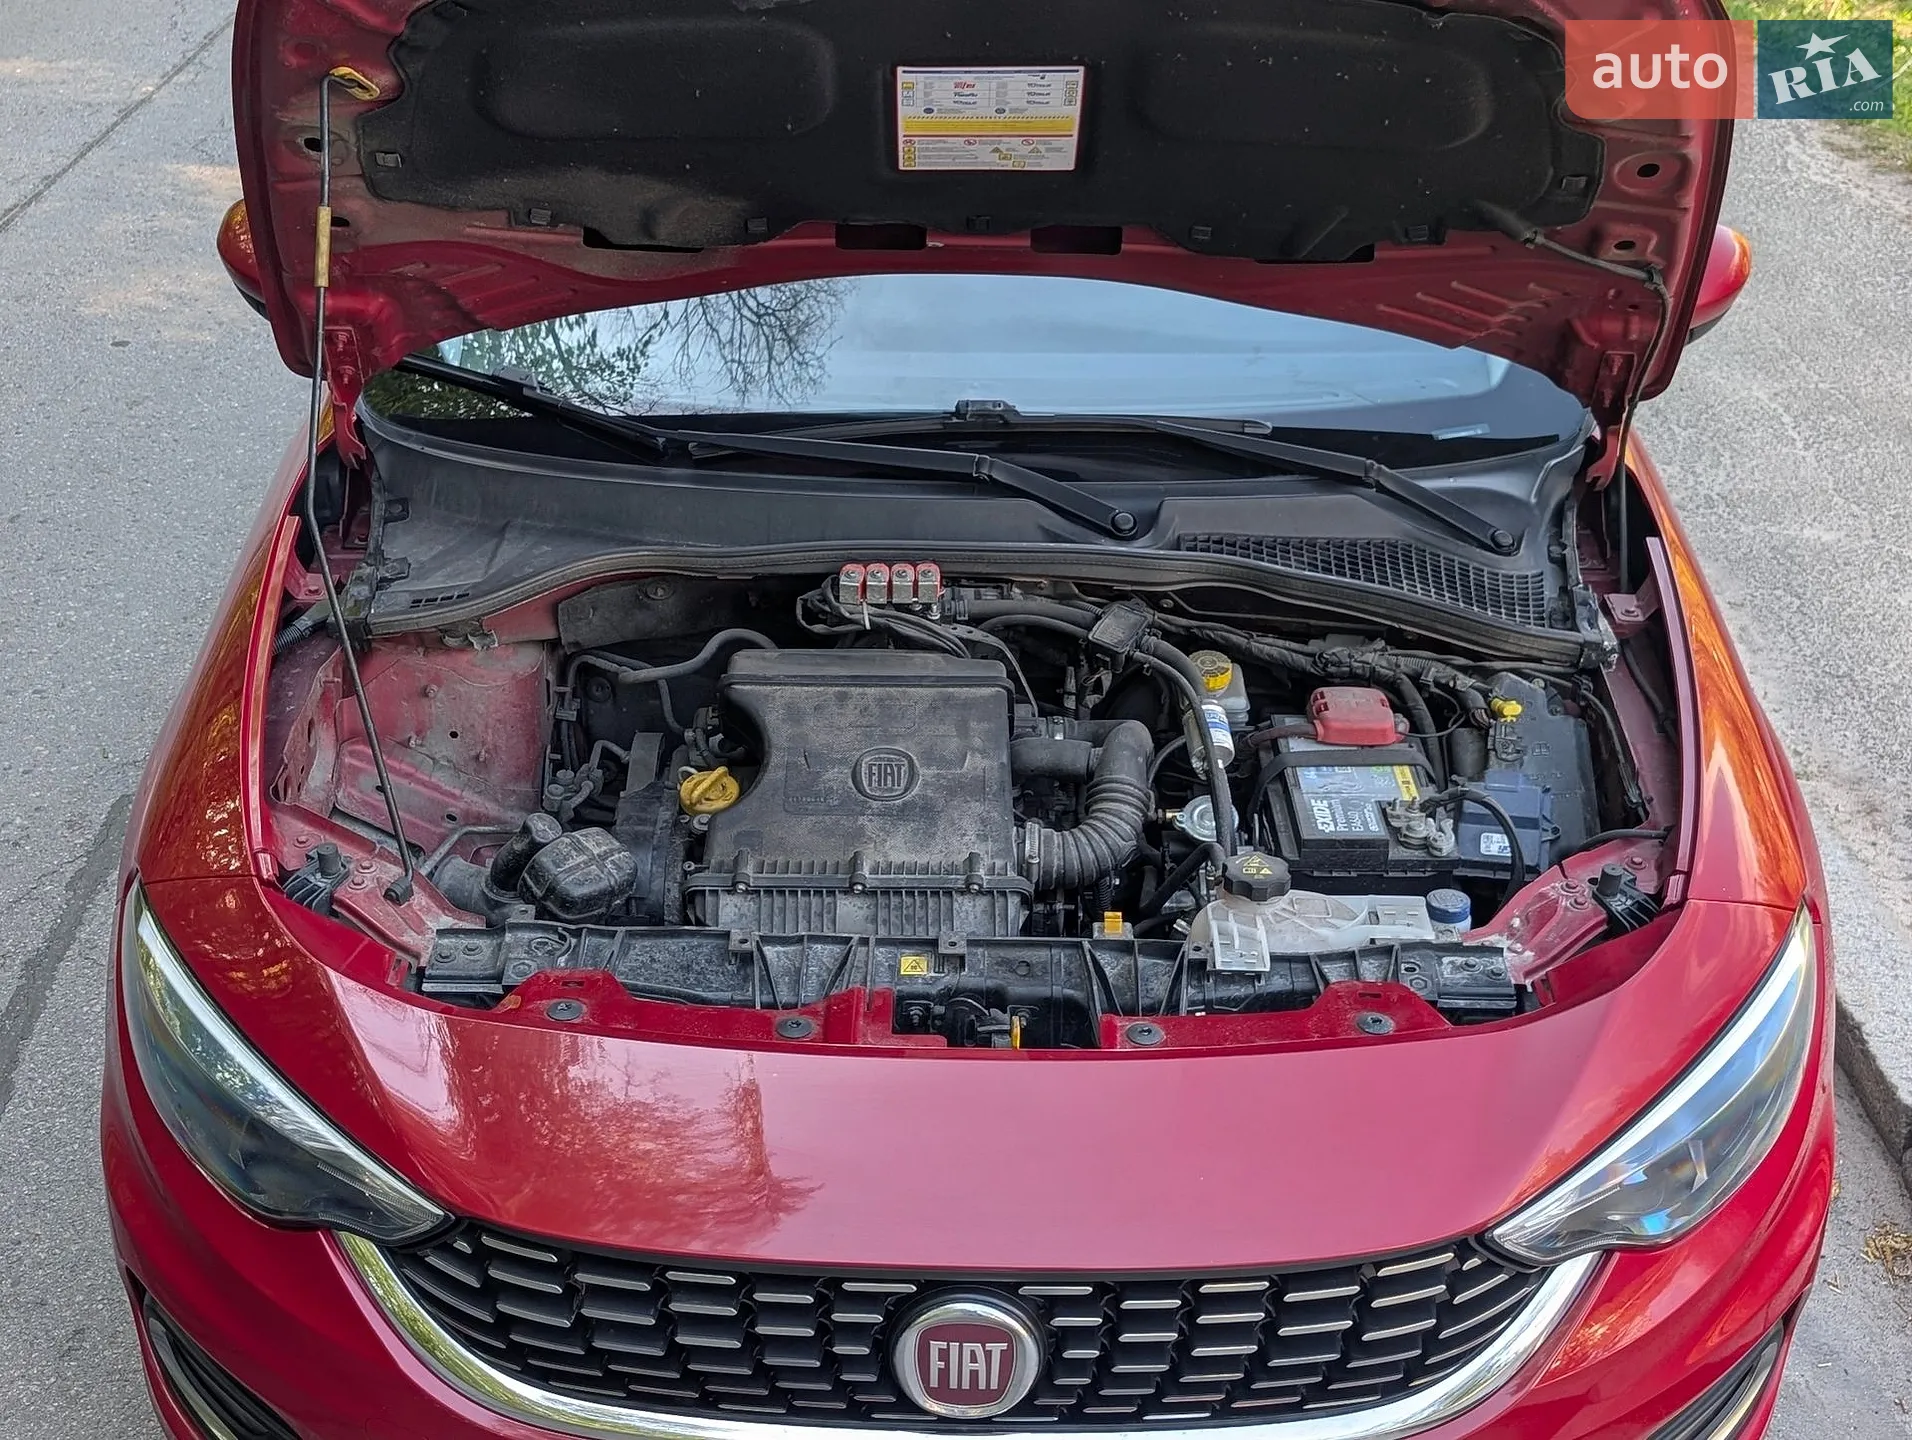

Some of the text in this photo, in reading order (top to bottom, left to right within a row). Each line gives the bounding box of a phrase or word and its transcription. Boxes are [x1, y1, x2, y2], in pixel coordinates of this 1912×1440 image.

[868, 762, 905, 788] FIAT
[1310, 798, 1335, 833] EXIDE
[1331, 799, 1349, 832] Premium
[929, 1340, 1009, 1390] FIAT
